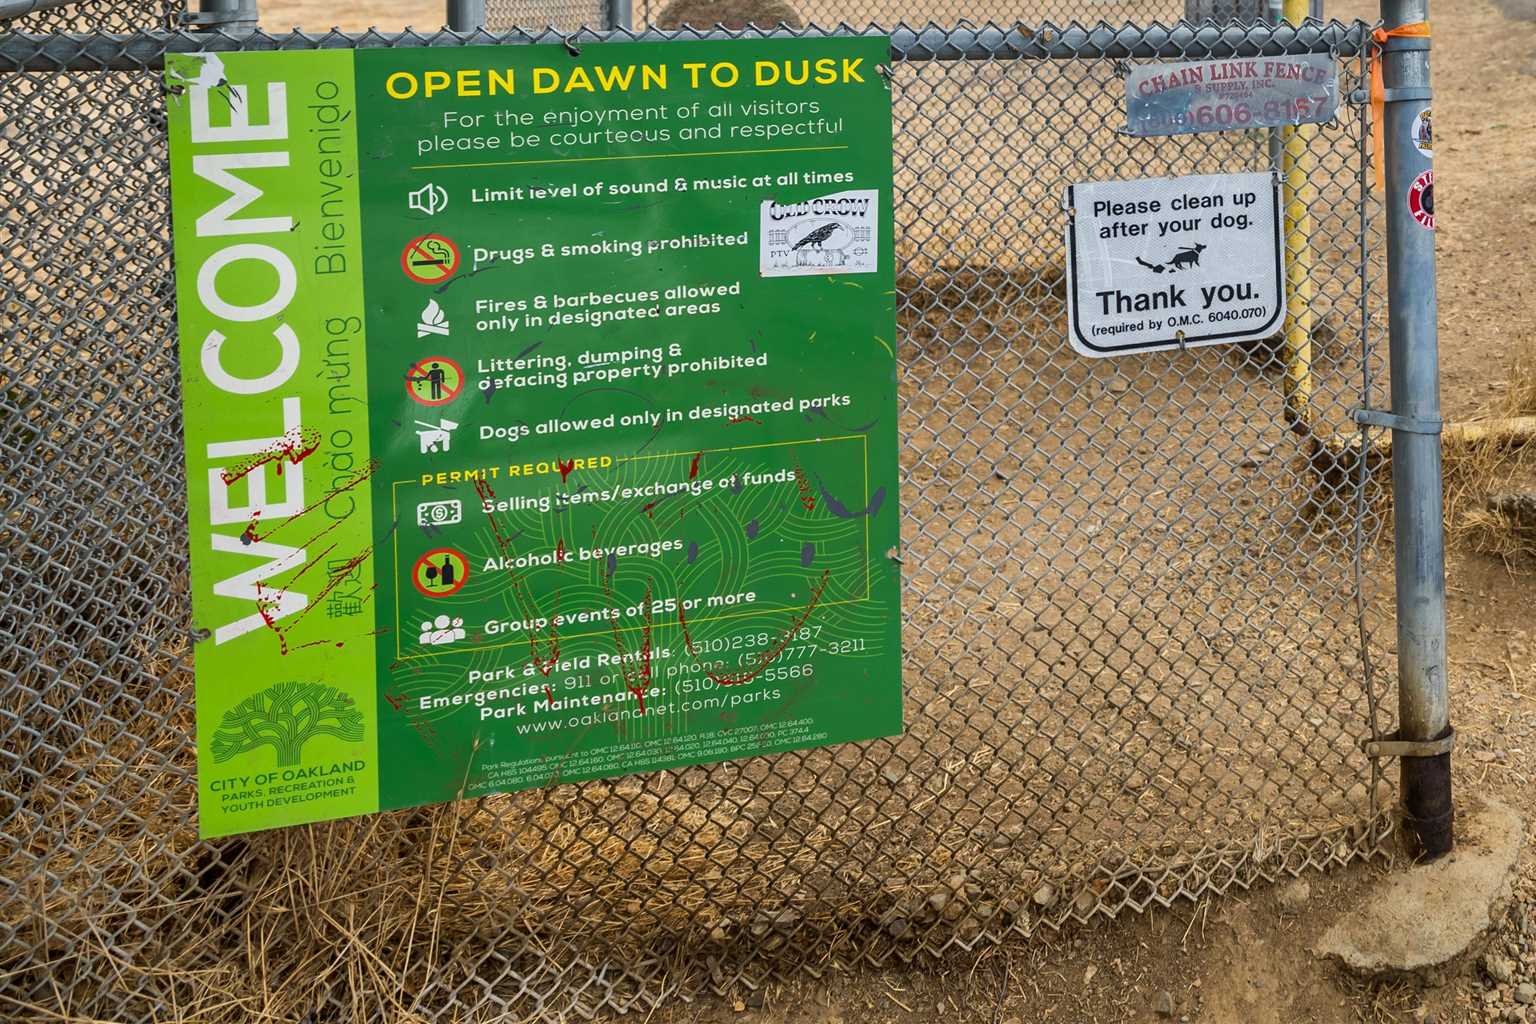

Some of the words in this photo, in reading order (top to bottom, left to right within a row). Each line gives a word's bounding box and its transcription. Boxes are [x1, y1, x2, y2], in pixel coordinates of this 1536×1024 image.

[386, 68, 515, 100] OPEN
[532, 64, 668, 95] DAWN
[682, 62, 740, 89] TO
[755, 57, 865, 86] DUSK
[1139, 64, 1203, 97] CHAIN
[1210, 61, 1257, 80] LINK
[1264, 62, 1328, 84] FENCE
[1205, 80, 1248, 94] SUPPLY,
[1252, 78, 1276, 88] INC.
[444, 111, 485, 128] For
[494, 109, 534, 126] the
[543, 104, 668, 128] enjoyment
[676, 102, 700, 120] of
[708, 101, 732, 118] all
[740, 99, 820, 116] visitors
[418, 135, 500, 156] please
[510, 132, 540, 148] be
[550, 128, 671, 146] courteous
[679, 123, 721, 140] and
[730, 117, 843, 140] respectful
[308, 80, 346, 274] Bienvenido
[472, 186, 524, 202] Limit
[530, 184, 577, 199] level
[583, 182, 603, 196] of
[608, 179, 668, 195] sound
[674, 178, 688, 192] &
[693, 175, 748, 190] music
[752, 174, 772, 188] at
[776, 172, 798, 186] all
[803, 171, 854, 185] times
[812, 198, 870, 218] CROW
[1094, 200, 1162, 218] Please
[1171, 194, 1224, 211] clean
[1232, 192, 1256, 208] up
[1100, 222, 1148, 239] after
[1158, 218, 1202, 238] your
[1210, 212, 1253, 230] dog.
[474, 247, 535, 264] Drugs
[541, 243, 556, 258] &
[560, 240, 642, 256] smoking
[647, 232, 748, 254] prohibited
[476, 298, 528, 314] Fires
[534, 295, 548, 310] &
[554, 290, 659, 308] barbecues
[664, 281, 740, 300] allowed
[1096, 284, 1186, 316] Thank
[1201, 282, 1260, 310] you.
[476, 316, 520, 332] only
[525, 314, 543, 328] in
[548, 304, 660, 326] designated
[665, 302, 721, 317] areas
[1091, 320, 1144, 337] (required
[1148, 318, 1163, 331] by
[1167, 314, 1204, 328] O.M.C.
[1208, 306, 1266, 323] 6040.070)
[190, 80, 309, 647] WELCOME
[478, 355, 572, 373] Littering,
[578, 347, 663, 365] dumping
[668, 343, 682, 356] &
[573, 363, 662, 385] property
[668, 352, 768, 376] prohibited
[480, 425, 530, 442] Dogs
[535, 414, 615, 434] allowed
[620, 410, 661, 426] only
[666, 408, 682, 422] in
[688, 398, 794, 420] designated
[799, 394, 851, 412] parks
[323, 429, 356, 520] Chào
[422, 467, 500, 486] PERMIT
[508, 456, 612, 476] REQURED
[482, 494, 550, 513] Selling
[556, 479, 712, 507] items/exchange
[742, 469, 796, 486] funds
[483, 550, 574, 572] Alcoholic
[580, 538, 684, 561] beverages
[484, 616, 548, 634] Group
[553, 608, 620, 626] events
[626, 602, 646, 617] of
[651, 598, 676, 614] 25
[682, 598, 702, 610] or
[708, 591, 756, 607] more
[420, 682, 556, 710] Emergencies:
[564, 675, 592, 690] 911
[600, 673, 618, 685] or
[667, 660, 729, 679] phone:
[468, 666, 516, 684] Park
[480, 704, 527, 720] Park
[210, 776, 250, 792] CITY
[254, 772, 278, 786] OF
[282, 760, 366, 782] OAKLAND
[222, 788, 266, 802] PARKS,
[268, 778, 345, 794] RECREATION
[347, 776, 354, 784] &
[222, 800, 264, 814] YOUTH
[266, 787, 357, 807] DEVELOPMENT
